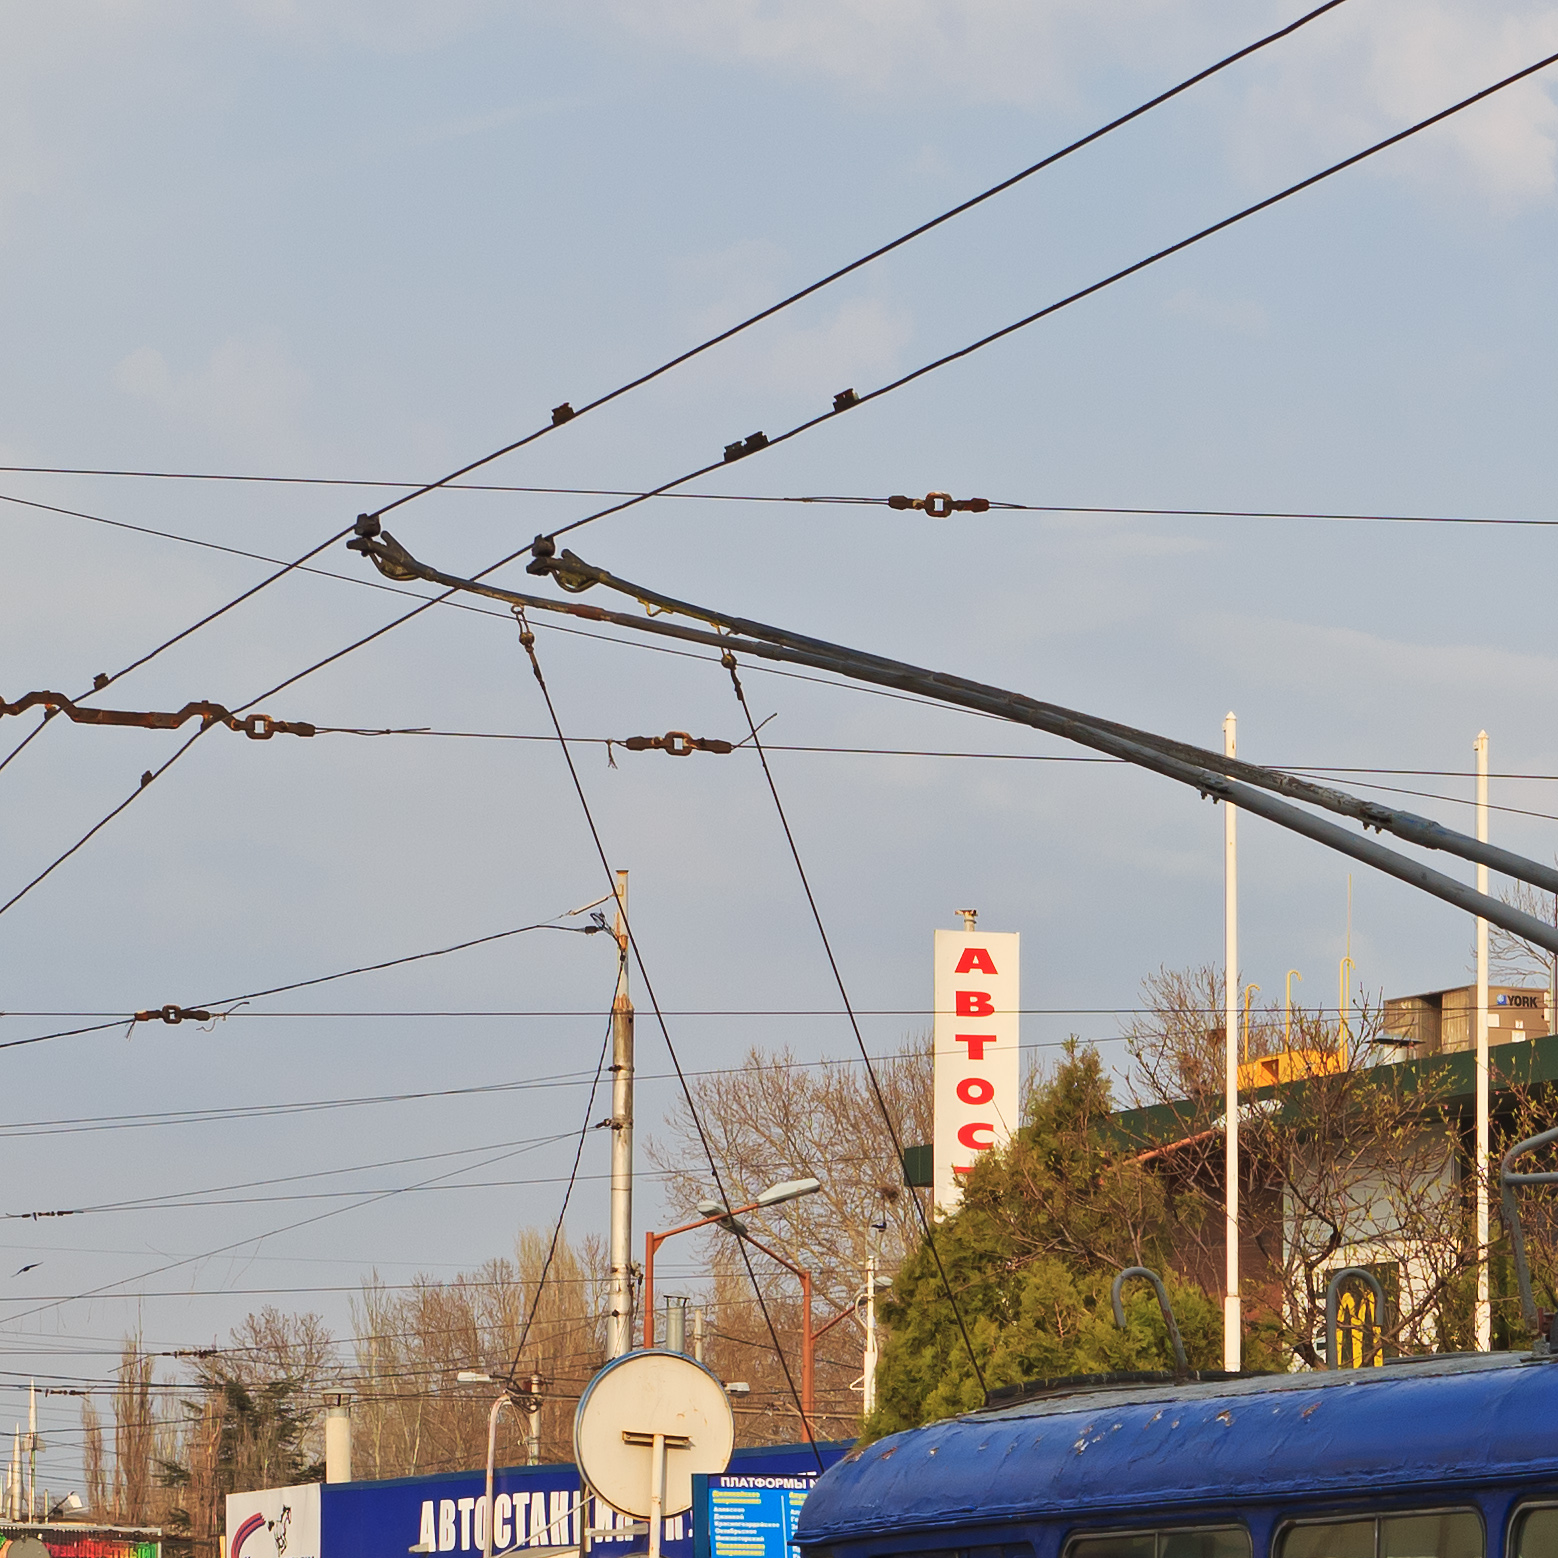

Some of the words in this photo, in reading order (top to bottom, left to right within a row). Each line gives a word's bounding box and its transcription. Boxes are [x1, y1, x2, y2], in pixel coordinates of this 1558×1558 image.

[1507, 995, 1537, 1008] YORK
[954, 948, 999, 1173] АВТОС
[721, 1477, 806, 1489] ПЛАТФОРМЫ
